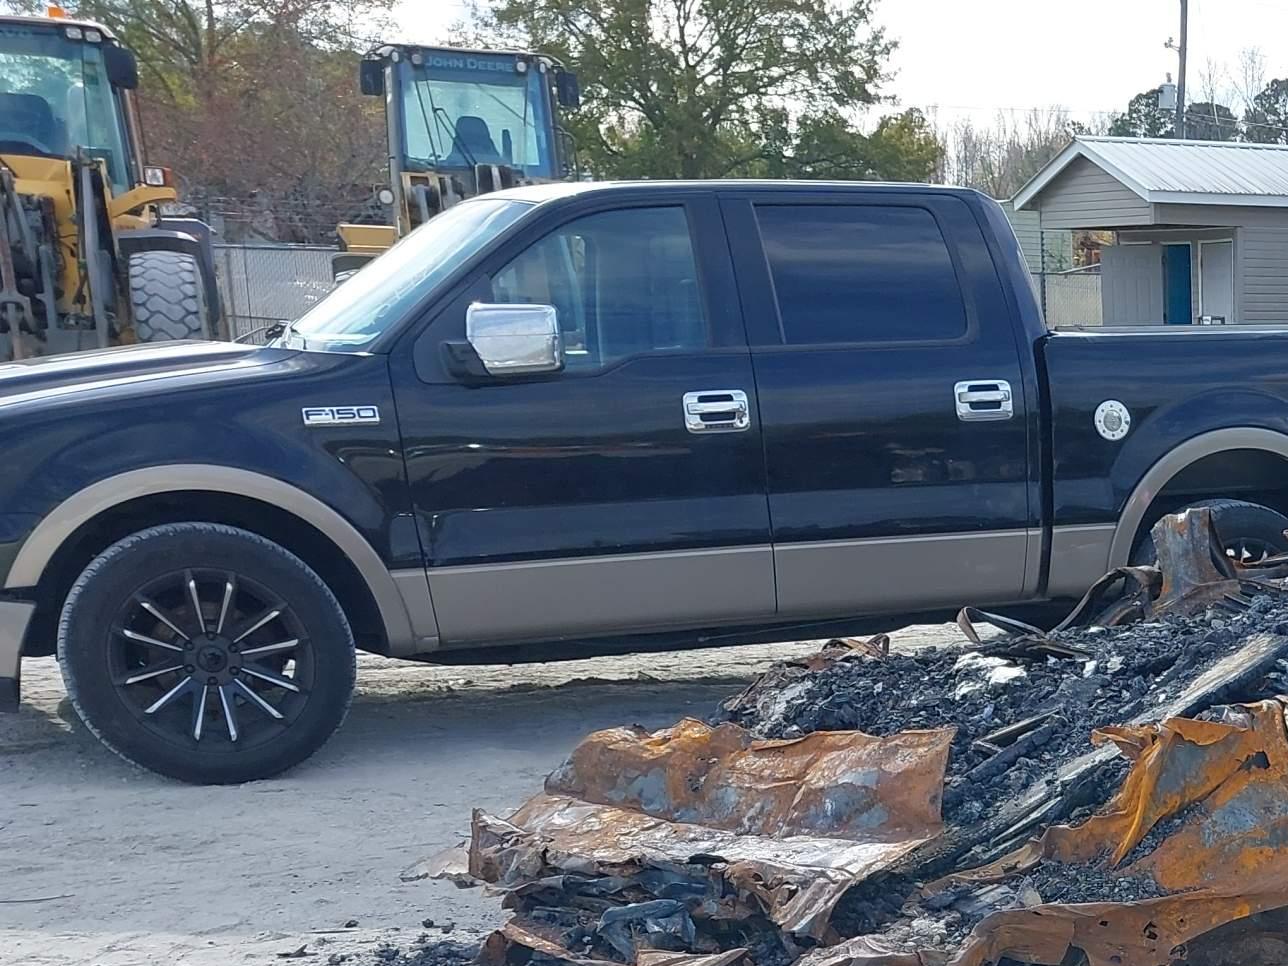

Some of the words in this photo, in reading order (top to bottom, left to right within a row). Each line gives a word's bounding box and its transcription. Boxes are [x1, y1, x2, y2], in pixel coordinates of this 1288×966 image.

[425, 56, 463, 68] JOHN
[467, 58, 514, 72] DEERE
[304, 407, 377, 421] F-150
